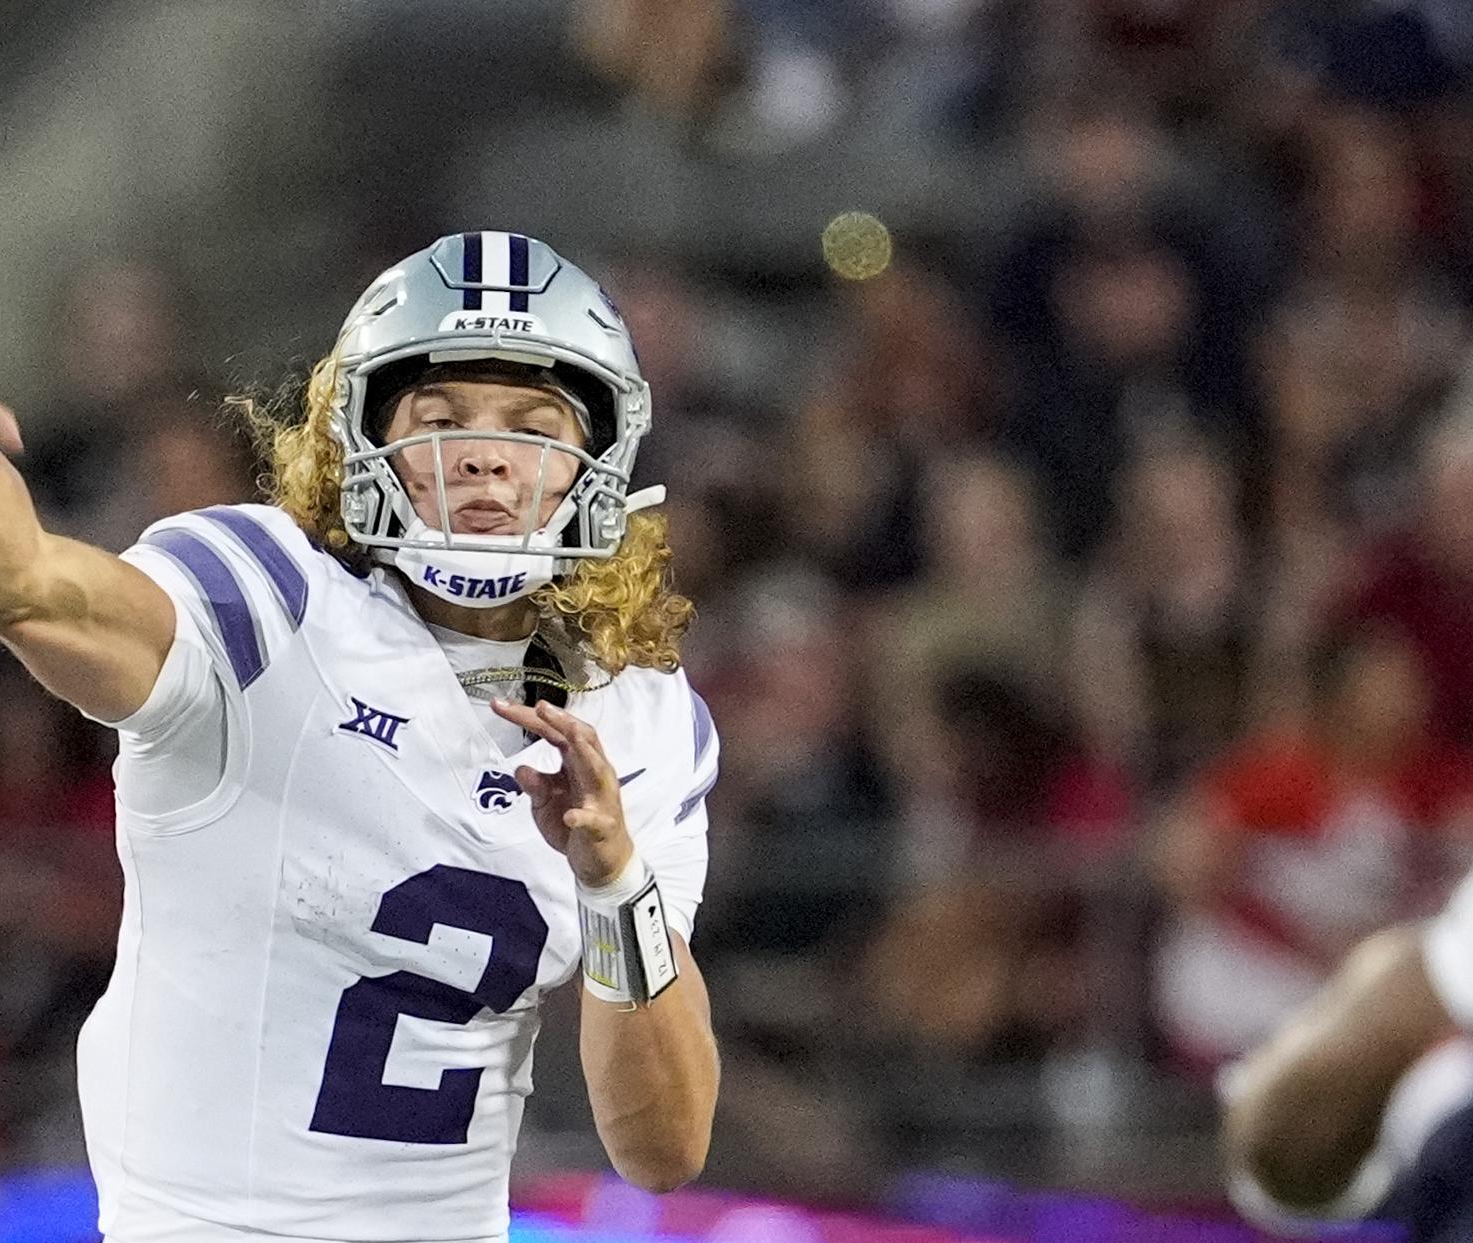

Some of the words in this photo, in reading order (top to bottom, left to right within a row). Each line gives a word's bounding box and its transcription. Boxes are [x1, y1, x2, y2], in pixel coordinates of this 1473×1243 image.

[454, 317, 534, 332] K-STATE
[423, 565, 527, 599] K-STATE
[338, 696, 410, 751] XII
[309, 863, 549, 1145] 2
